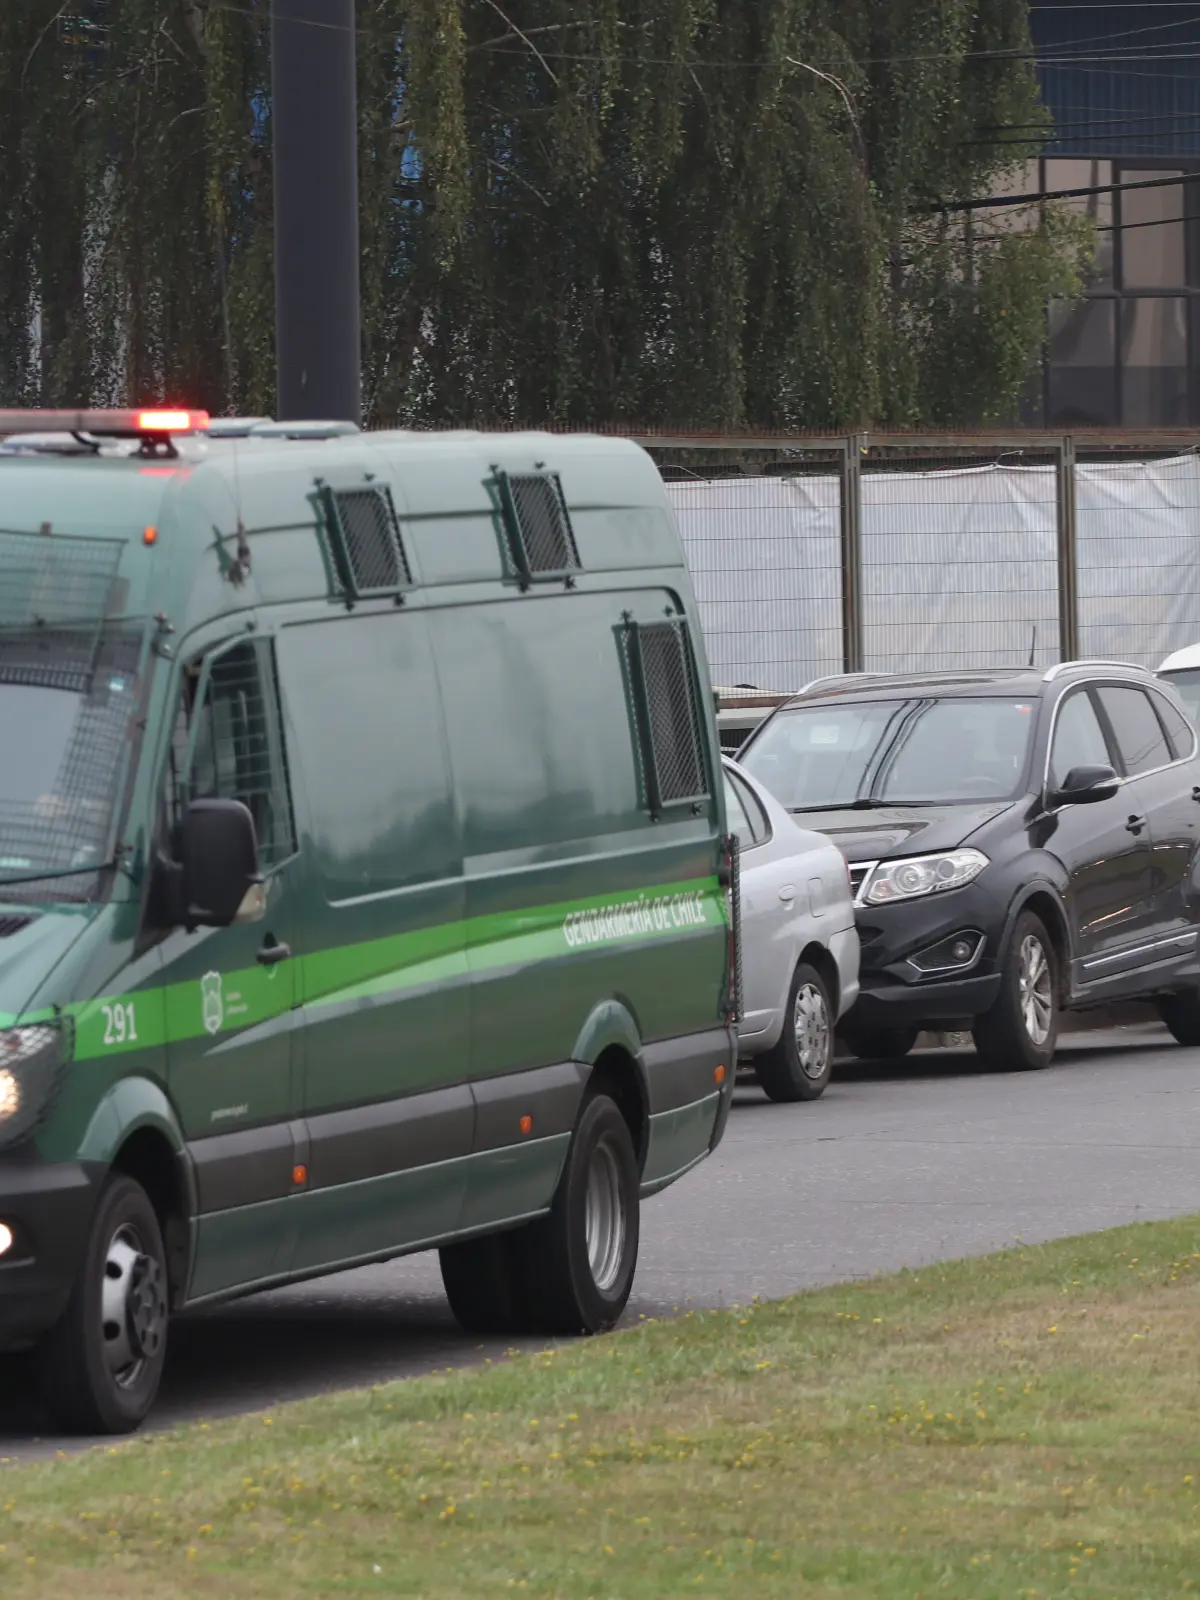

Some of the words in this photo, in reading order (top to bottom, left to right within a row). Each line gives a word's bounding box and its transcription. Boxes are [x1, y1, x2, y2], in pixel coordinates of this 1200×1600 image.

[653, 895, 671, 931] DE
[670, 889, 706, 927] CHILE
[101, 1001, 138, 1045] 291
